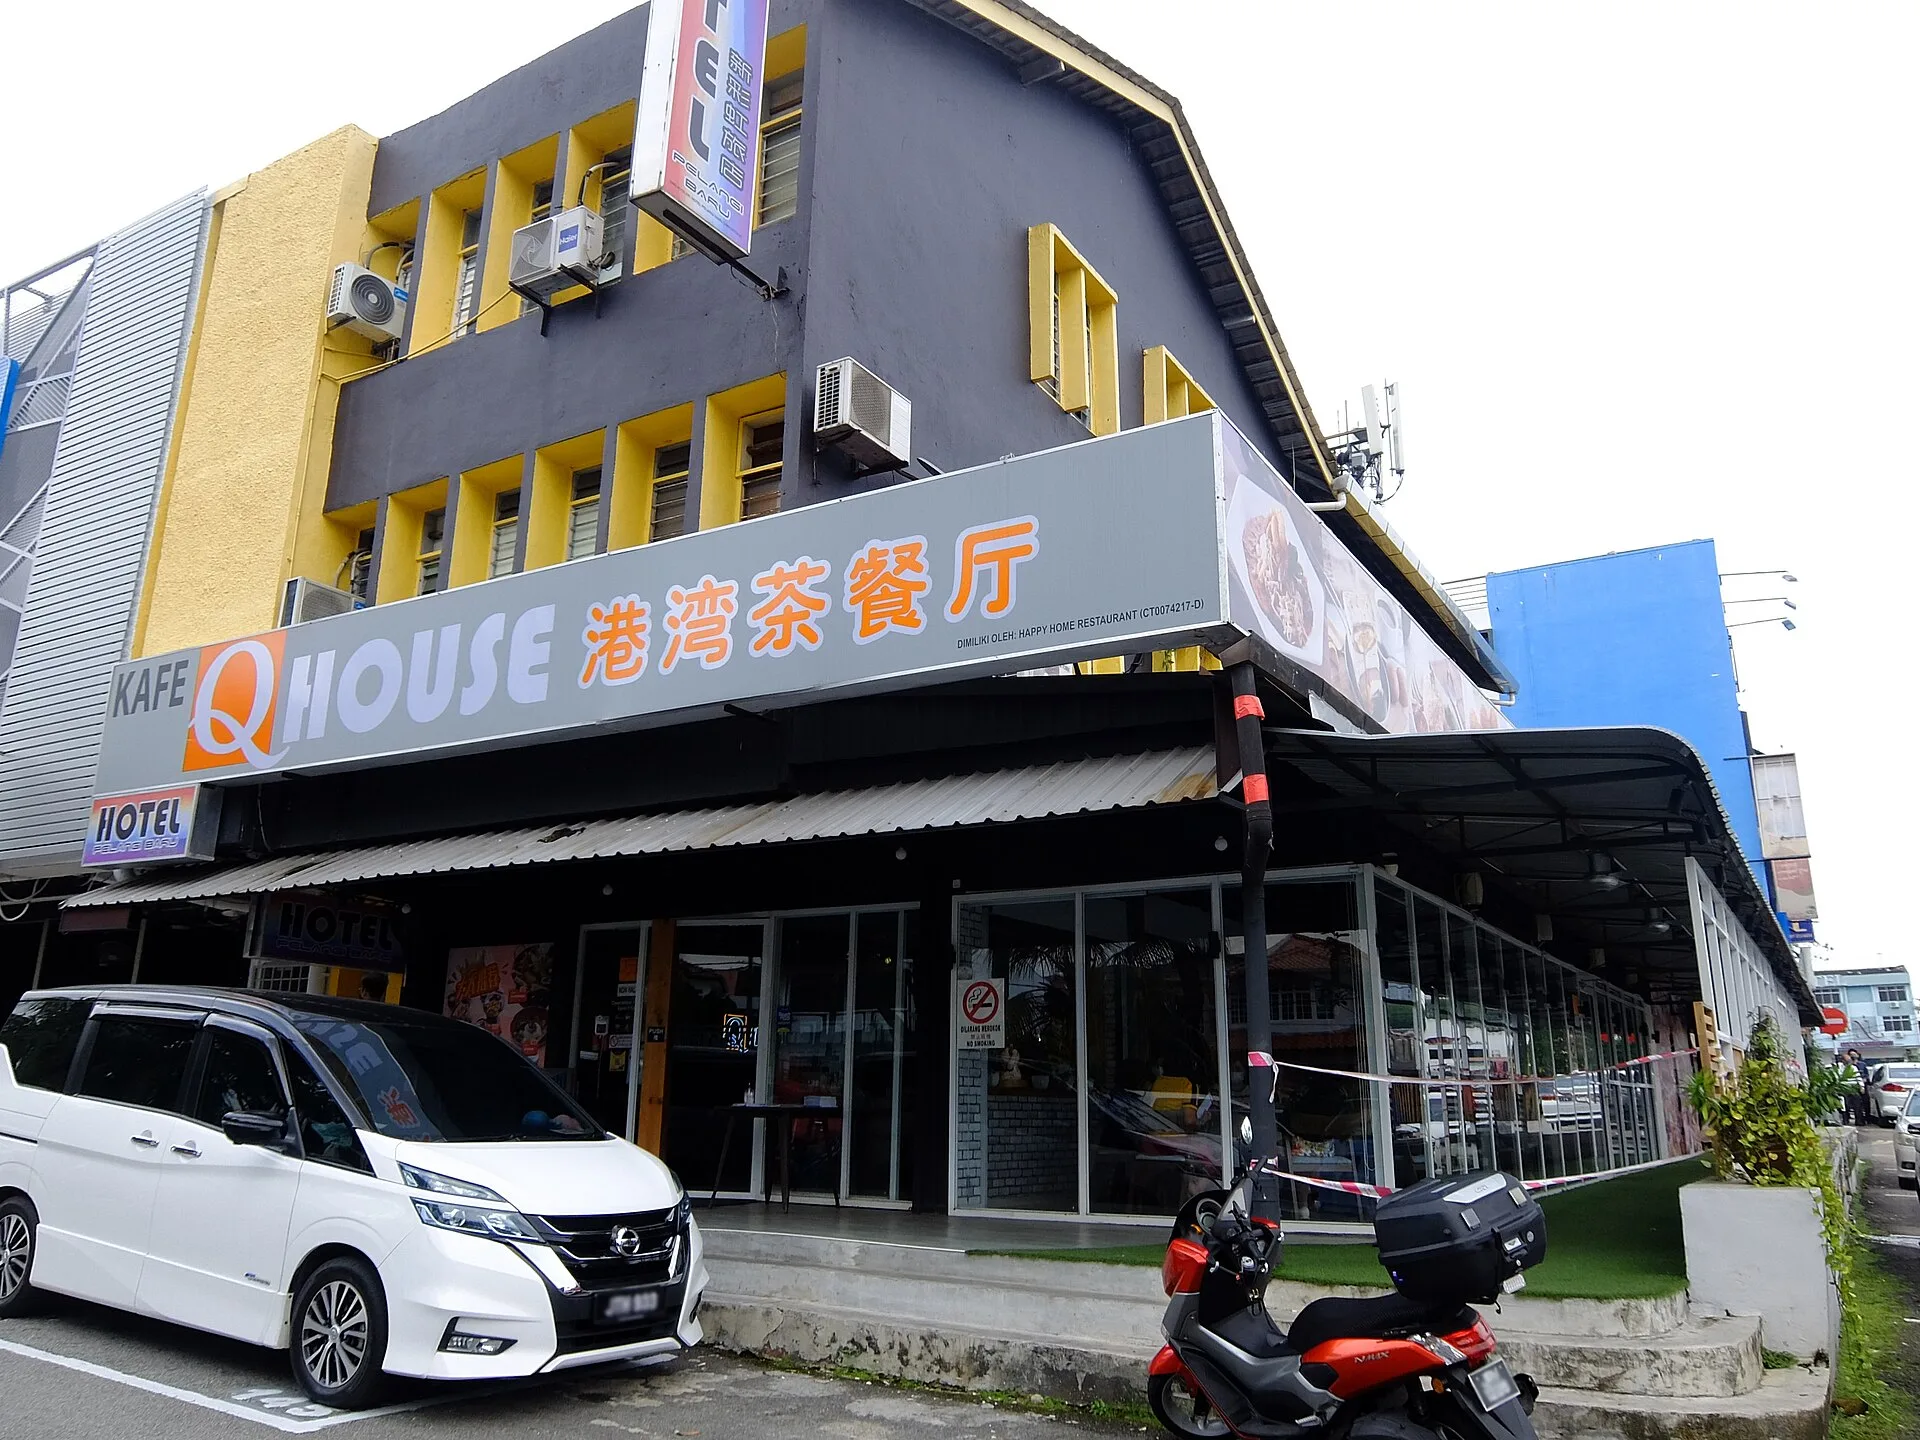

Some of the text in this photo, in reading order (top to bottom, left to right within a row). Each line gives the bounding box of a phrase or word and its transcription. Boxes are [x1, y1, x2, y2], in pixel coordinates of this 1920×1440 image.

[719, 47, 754, 192] 新彩虹旅店
[672, 150, 745, 216] PELANGI
[684, 176, 731, 220] BARU
[578, 515, 1040, 689] 港湾茶餐厅
[957, 598, 1205, 649] DIMILIKI OLEH: HAPPY HOME RESTAURANT (CT0074217-D)
[113, 604, 555, 769] KAFE Q HOUSE
[96, 797, 181, 842] HOTEL
[144, 837, 179, 850] BARU
[278, 901, 393, 951] HOTEL
[960, 1024, 1001, 1033] DILARANG MEROKOK
